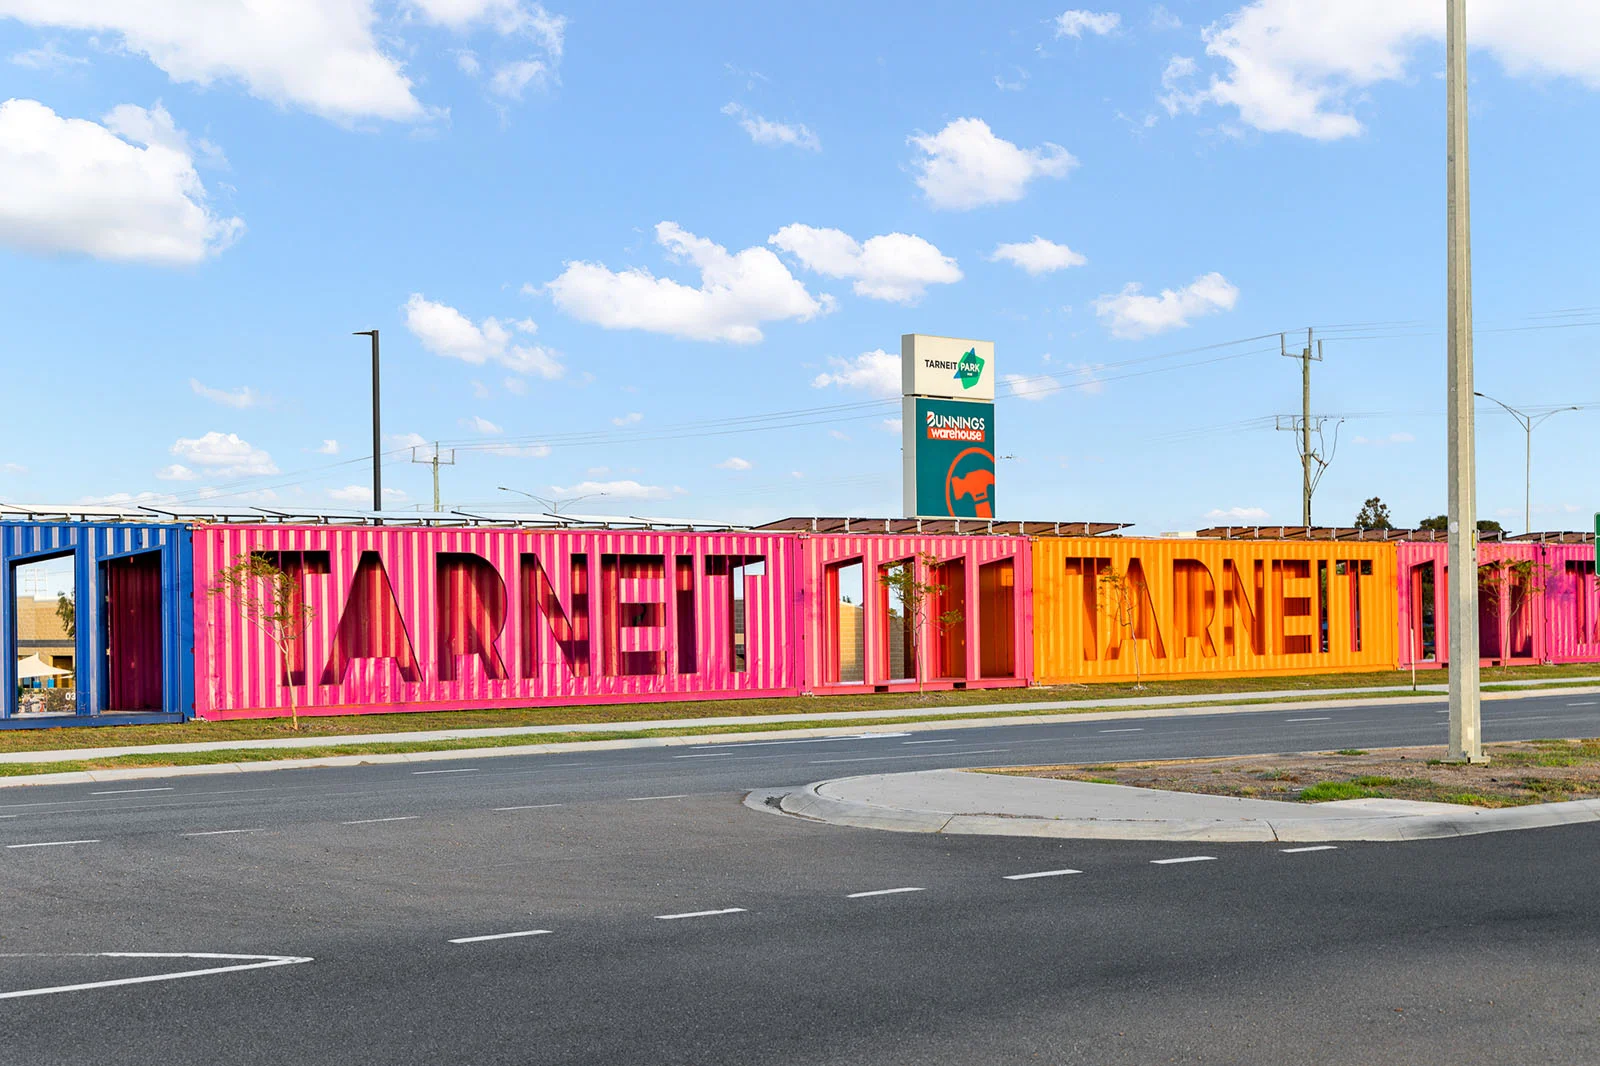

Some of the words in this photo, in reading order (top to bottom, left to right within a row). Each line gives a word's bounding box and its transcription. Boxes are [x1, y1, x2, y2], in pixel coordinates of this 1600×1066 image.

[924, 360, 957, 370] TARNEIT
[960, 363, 980, 372] PARK
[926, 411, 985, 430] BUNNINGS
[931, 426, 982, 440] warehouse
[251, 550, 766, 686] TARNEIT
[1065, 556, 1374, 661] TARNEIT
